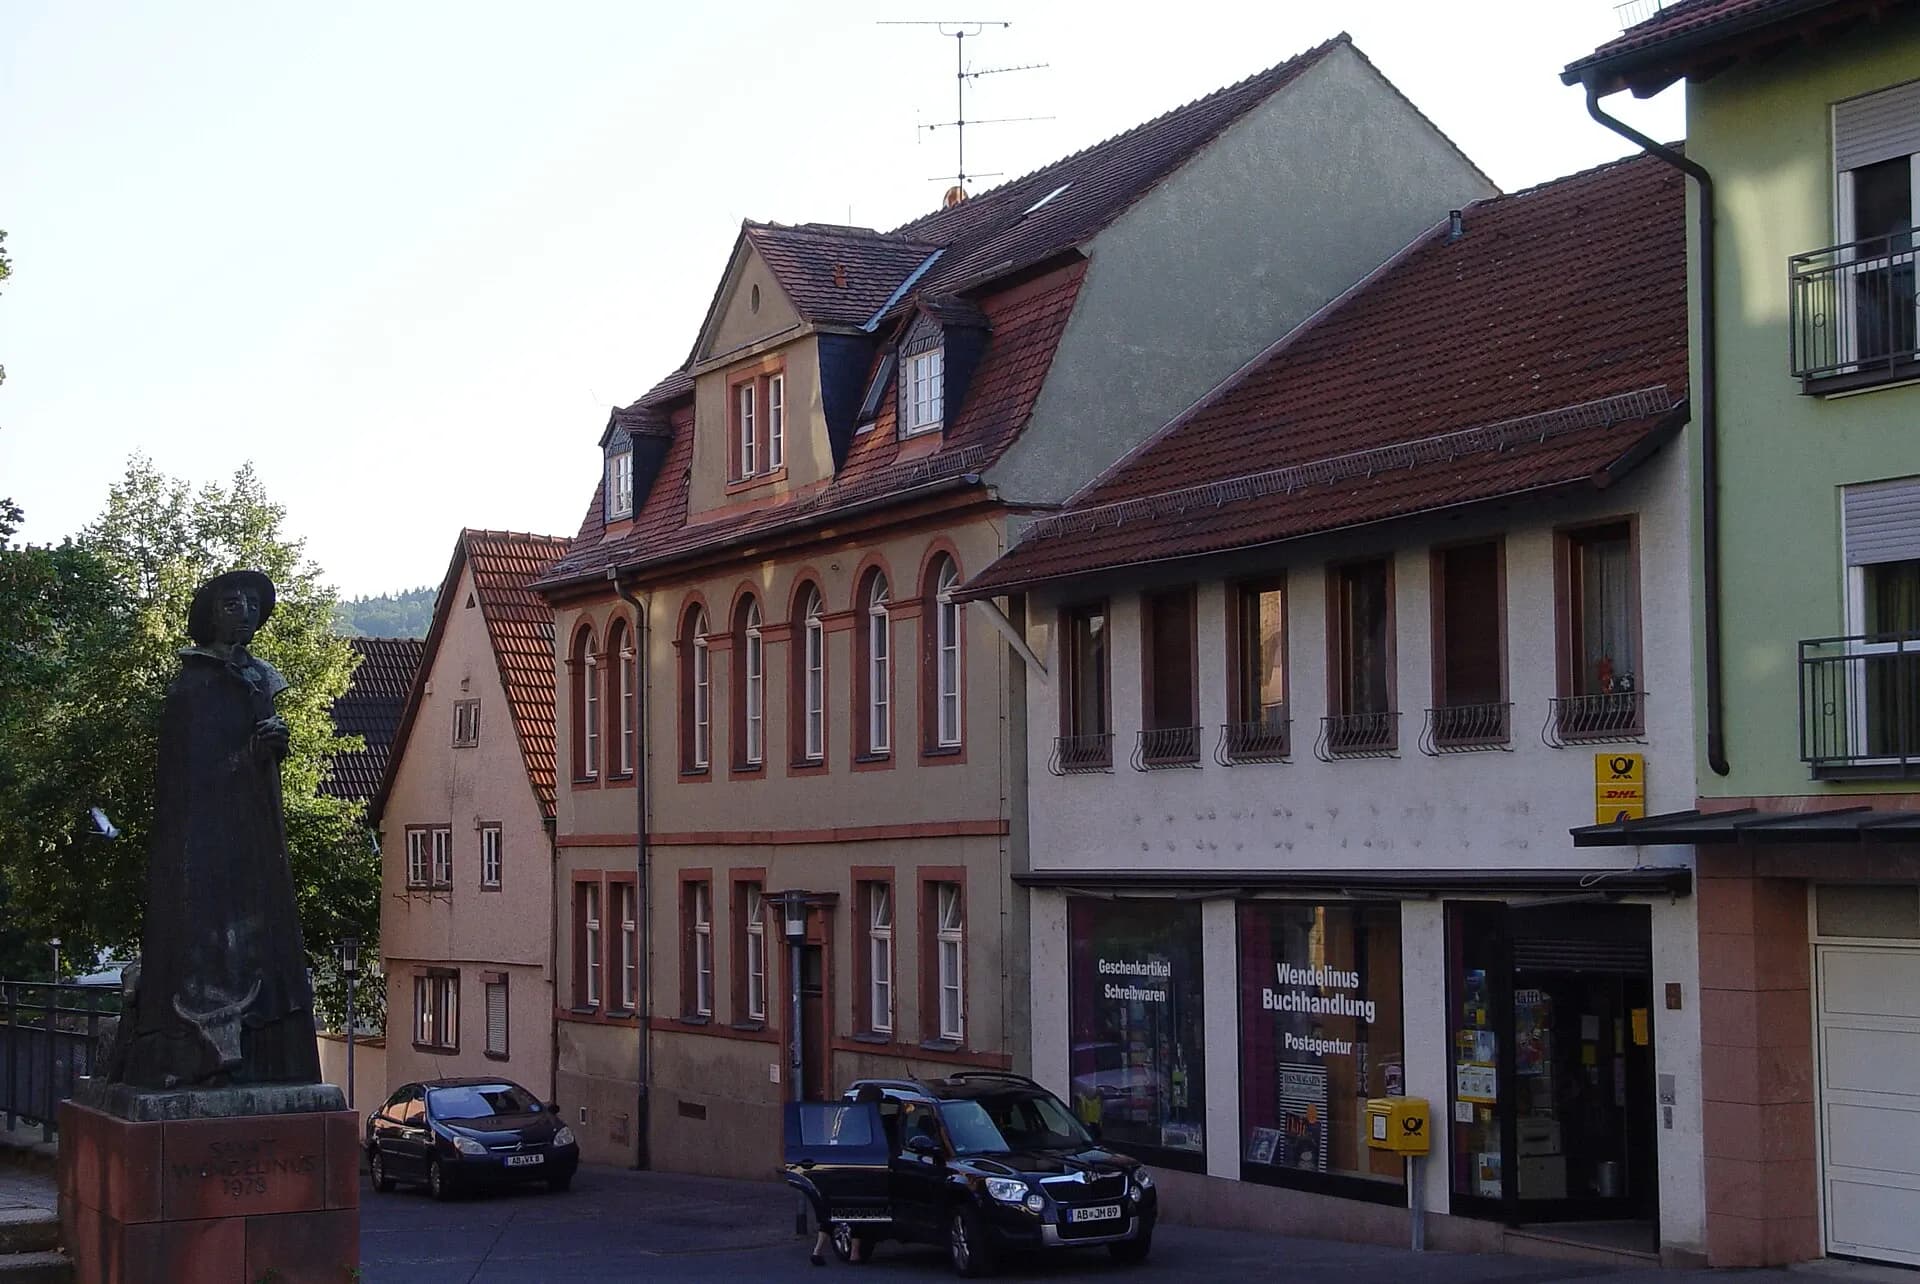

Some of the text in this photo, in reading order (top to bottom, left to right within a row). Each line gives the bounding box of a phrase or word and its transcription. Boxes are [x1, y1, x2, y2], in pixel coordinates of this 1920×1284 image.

[1607, 790, 1637, 799] DHL
[1098, 958, 1171, 977] Geschenkartikel
[1276, 962, 1359, 989] Wendelinus
[1104, 983, 1166, 1002] Schreibwaren
[1262, 987, 1376, 1024] Buchhandlung
[1284, 1032, 1352, 1057] Postagentur
[171, 1154, 317, 1179] WENDELINUS
[222, 1177, 267, 1198] 1978
[1077, 1207, 1118, 1220] AB JM 89
